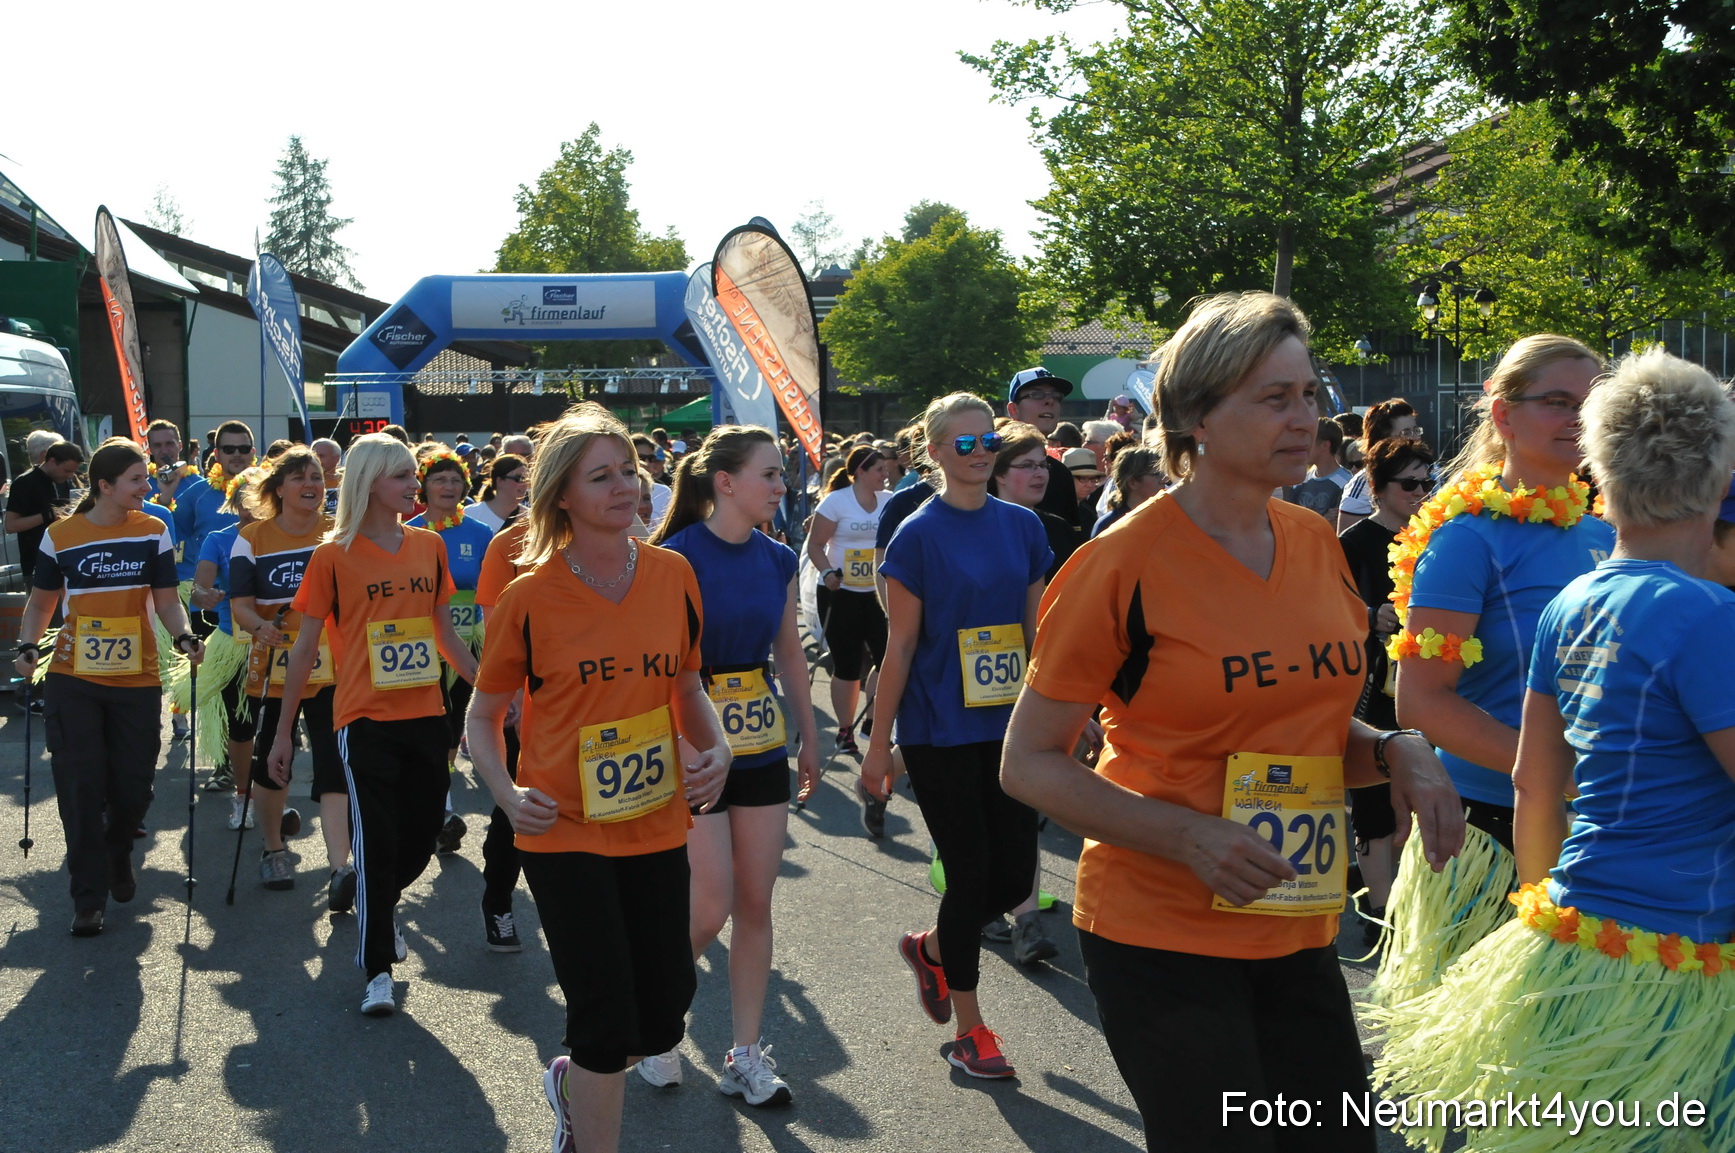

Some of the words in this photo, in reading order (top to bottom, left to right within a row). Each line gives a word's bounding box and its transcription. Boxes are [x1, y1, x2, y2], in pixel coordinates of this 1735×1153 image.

[531, 305, 607, 320] firmenlauf
[385, 331, 428, 341] Fischer
[91, 560, 146, 573] Fischer
[96, 570, 142, 579] AUTOMOBILE
[84, 637, 132, 661] 373
[380, 641, 431, 673] 923
[974, 651, 1021, 686] 650
[722, 695, 776, 735] 656
[596, 744, 665, 800] 925
[1255, 780, 1310, 795] firmenlauf
[1234, 797, 1283, 812] walken
